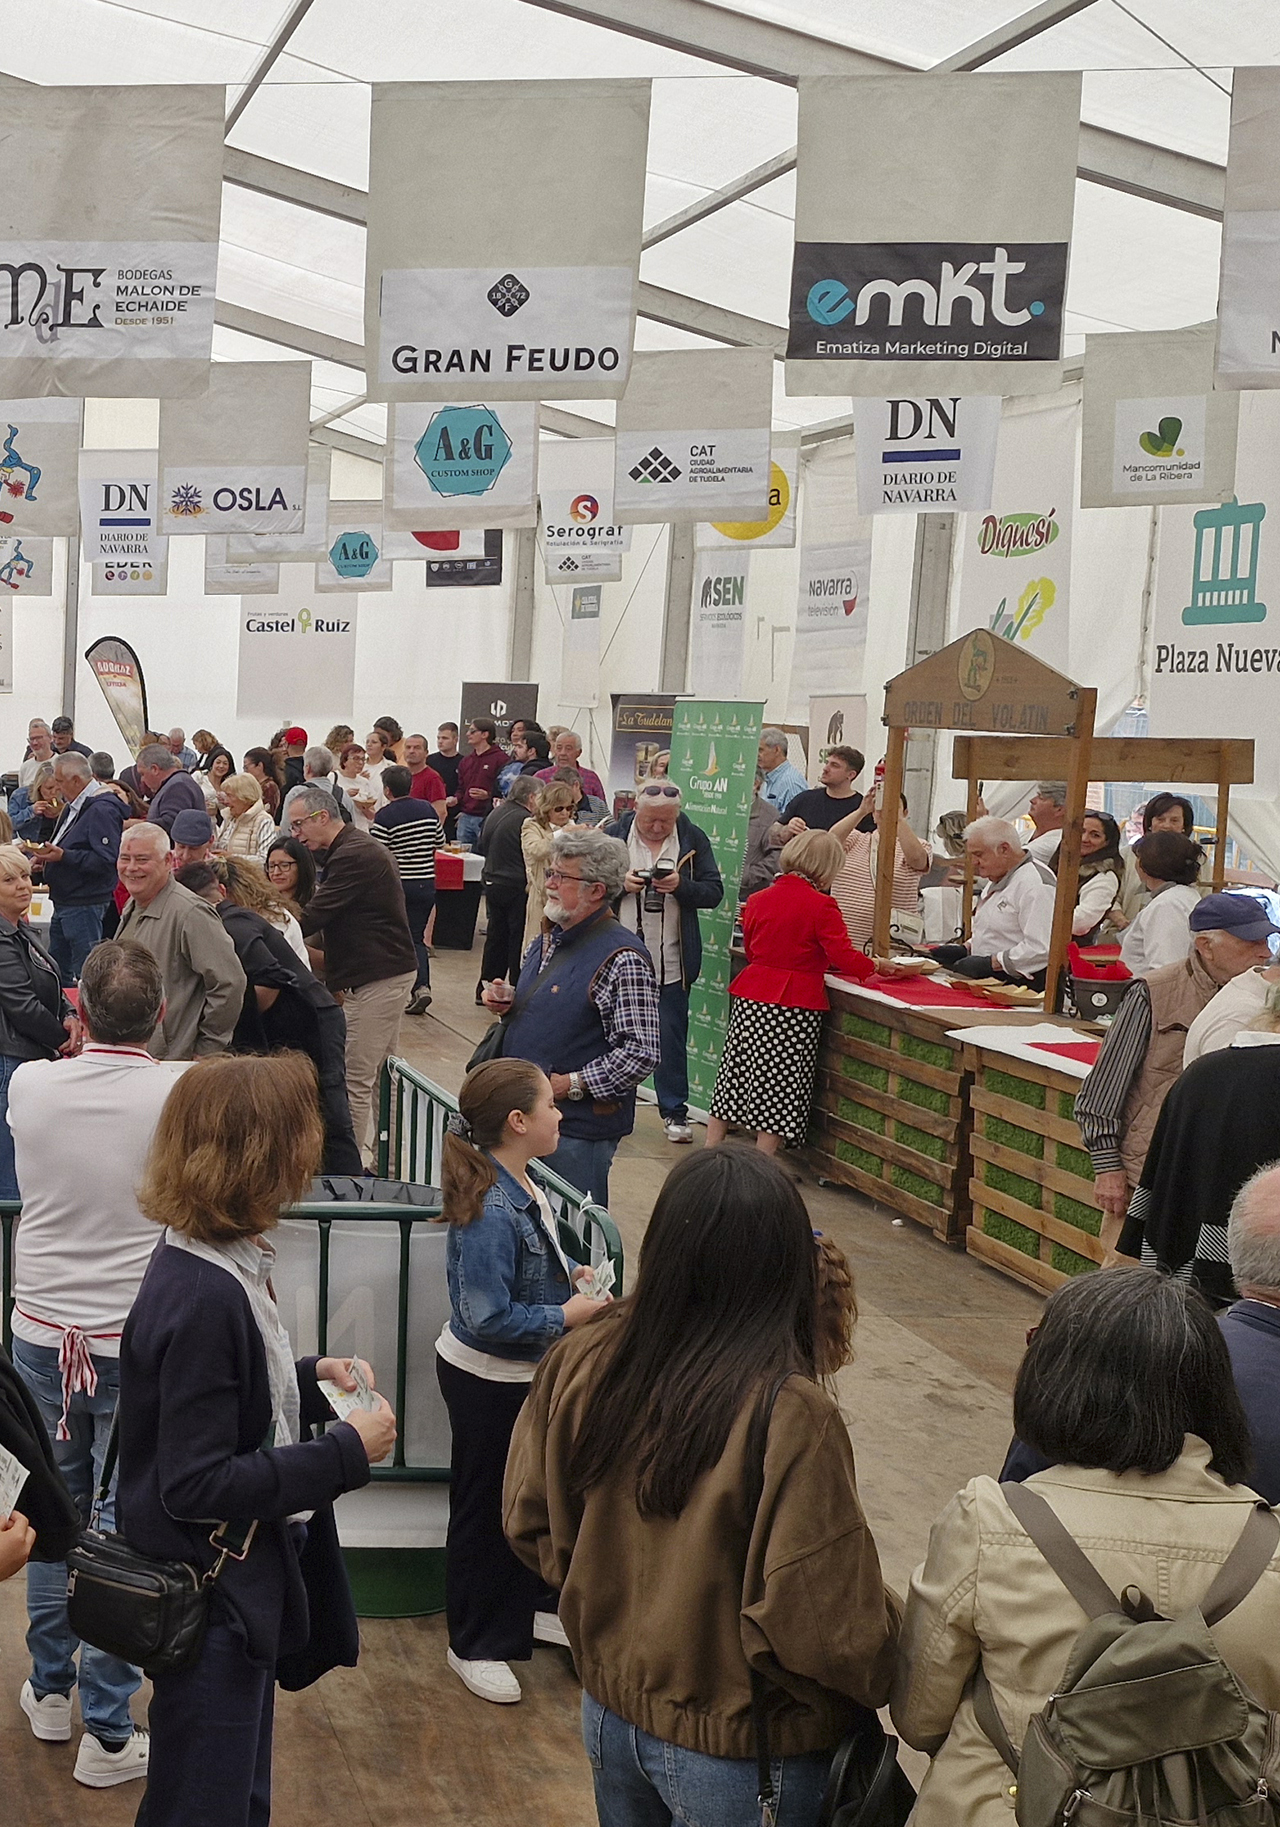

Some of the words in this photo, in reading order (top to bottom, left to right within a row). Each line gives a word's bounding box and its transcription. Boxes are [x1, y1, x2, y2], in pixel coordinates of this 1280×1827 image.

[117, 269, 173, 281] BODEGAS
[115, 285, 174, 298] MALON
[179, 285, 201, 297] DE
[115, 300, 188, 312] ECHAIDE
[816, 341, 879, 355] Ematiza
[884, 339, 970, 359] Marketing
[975, 339, 1028, 358] Digital
[393, 345, 493, 374] GRAN
[505, 345, 620, 373] FEUDO
[885, 398, 961, 441] DN
[690, 445, 715, 456] CAT
[431, 470, 469, 478] CUSTOM
[472, 468, 495, 477] SHOP
[689, 466, 753, 474] AGROALIMENTARIA
[1122, 461, 1200, 473] Mancomunidad
[700, 475, 725, 483] TUDELA
[882, 472, 935, 486] DIARIO
[937, 471, 957, 484] DE
[1130, 472, 1143, 482] de
[1145, 472, 1157, 482] La
[1160, 470, 1193, 481] Ribera
[101, 484, 150, 512] DN
[213, 487, 288, 512] OSLA
[882, 488, 957, 504] NAVARRA
[100, 533, 133, 541] DIARIO
[136, 533, 148, 541] DE
[546, 525, 623, 539] Serograf
[100, 545, 149, 553] NAVARRA
[713, 576, 744, 607] SEN
[809, 578, 852, 597] Navarra
[246, 618, 295, 632] Castel
[315, 619, 350, 632] Ruiz
[1155, 645, 1208, 673] Plaza
[635, 712, 673, 727] Tudelan
[904, 701, 943, 725] ORDEN
[953, 702, 976, 727] DEL
[992, 703, 1049, 730] VOLATIN
[690, 776, 712, 793] Grupo
[713, 777, 728, 792] AN
